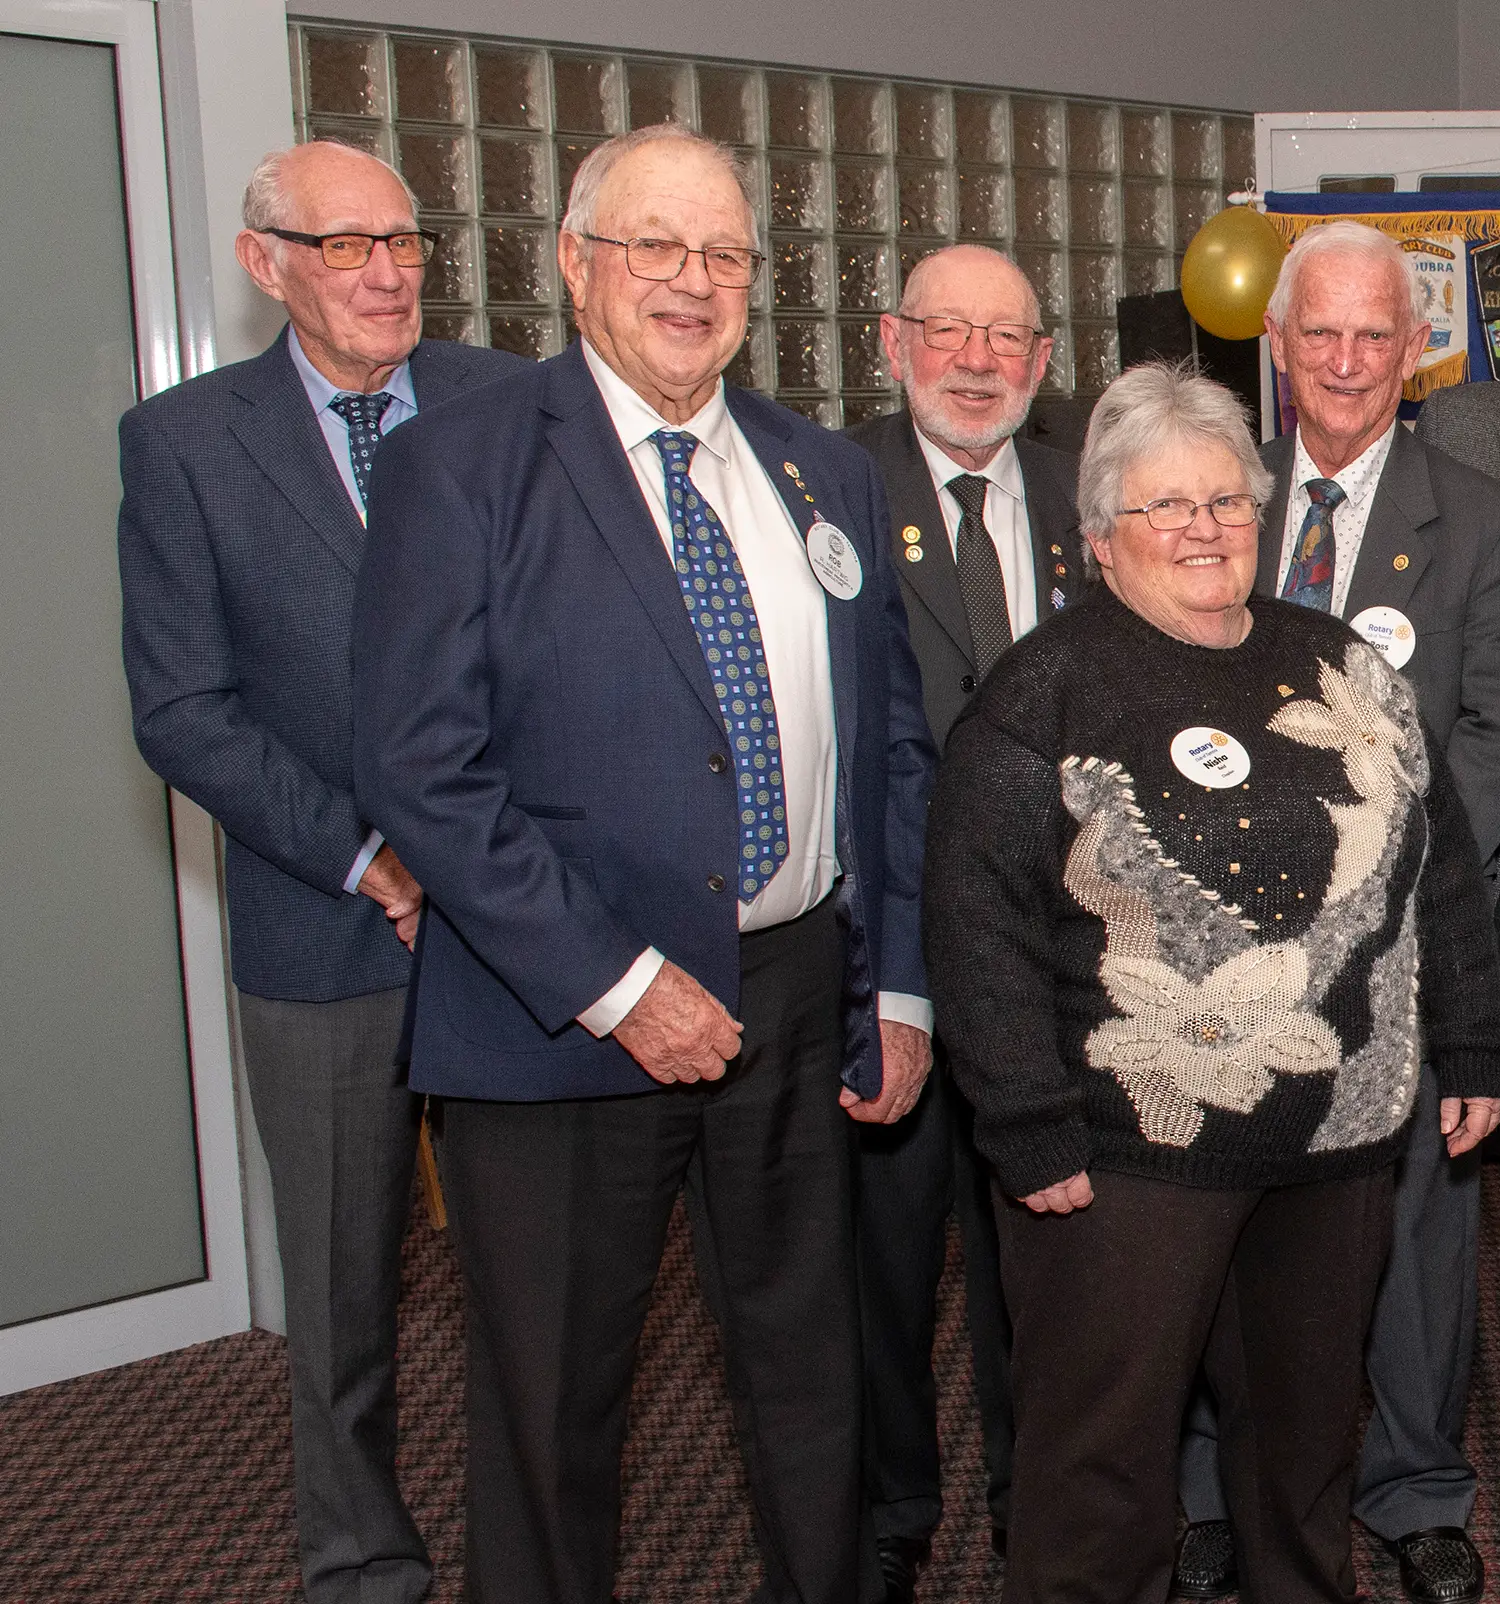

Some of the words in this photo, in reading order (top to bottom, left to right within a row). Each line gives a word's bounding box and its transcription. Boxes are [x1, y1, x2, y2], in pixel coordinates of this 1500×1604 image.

[1402, 240, 1422, 253] ARY
[1415, 262, 1454, 273] UBRA
[1367, 623, 1394, 635] Rotary
[1370, 640, 1389, 651] Ross
[1188, 742, 1214, 756] Rotary
[1203, 754, 1229, 770] Nisha
